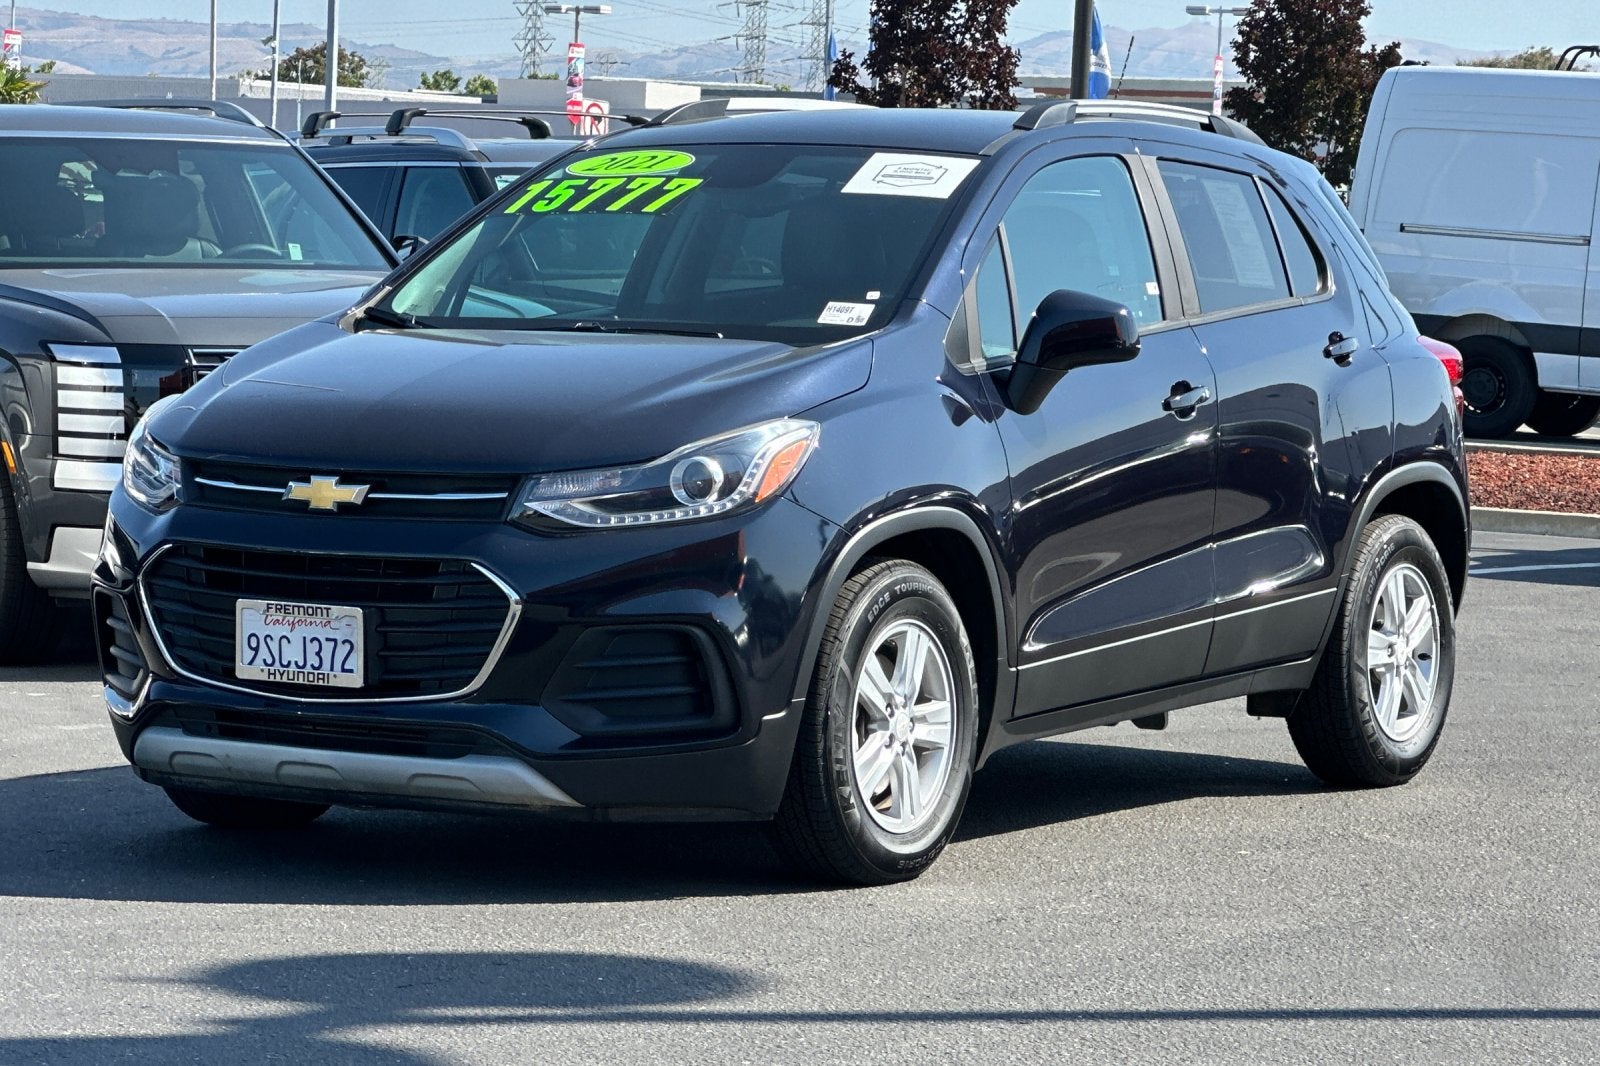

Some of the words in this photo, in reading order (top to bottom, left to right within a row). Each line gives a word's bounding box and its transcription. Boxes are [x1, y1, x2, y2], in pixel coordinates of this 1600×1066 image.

[585, 154, 678, 172] 2021
[504, 177, 704, 214] 15777
[265, 603, 332, 618] FREMONT
[867, 591, 891, 623] EDGE
[894, 582, 933, 595] TOURING
[264, 614, 340, 633] California
[247, 632, 355, 674] 9SCJ372
[267, 668, 331, 684] HYUNDAI
